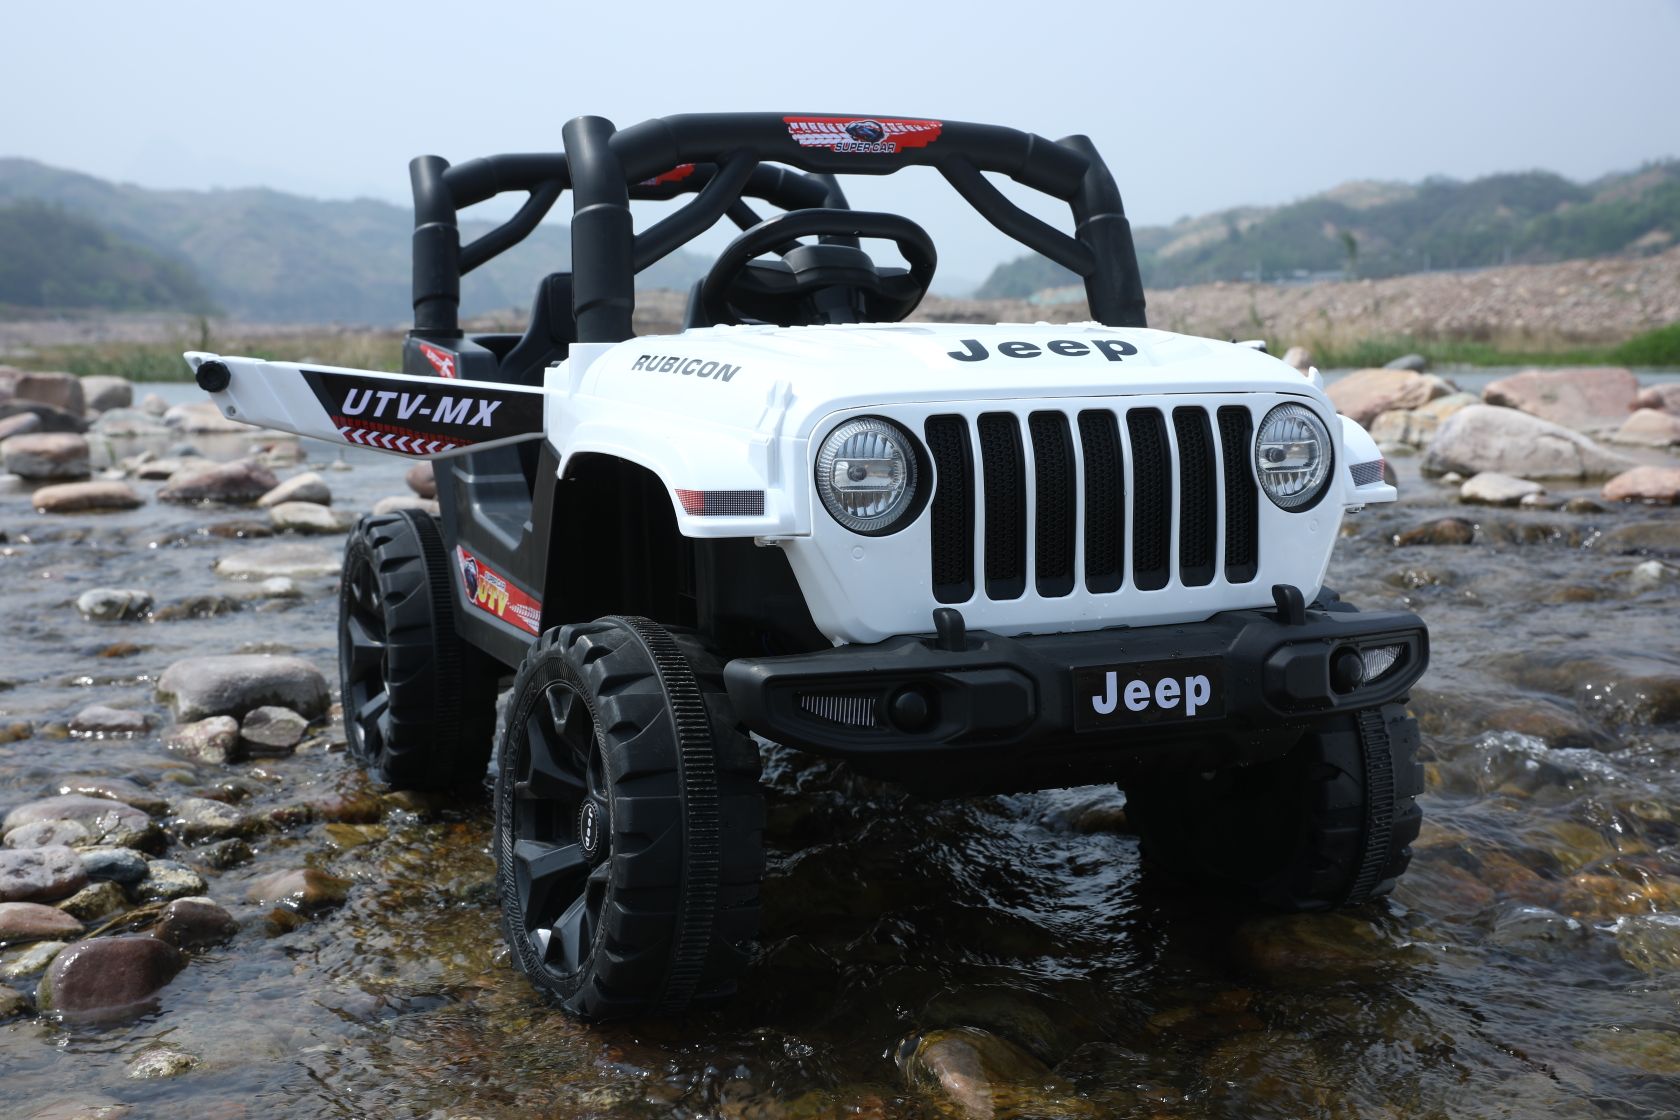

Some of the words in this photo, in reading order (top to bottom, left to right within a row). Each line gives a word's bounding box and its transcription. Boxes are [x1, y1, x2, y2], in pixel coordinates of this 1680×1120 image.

[631, 354, 742, 382] RUBICON
[947, 338, 1138, 362] Jeep
[341, 388, 502, 427] UTV-MX
[477, 574, 509, 617] UTV
[1092, 671, 1211, 716] Jeep
